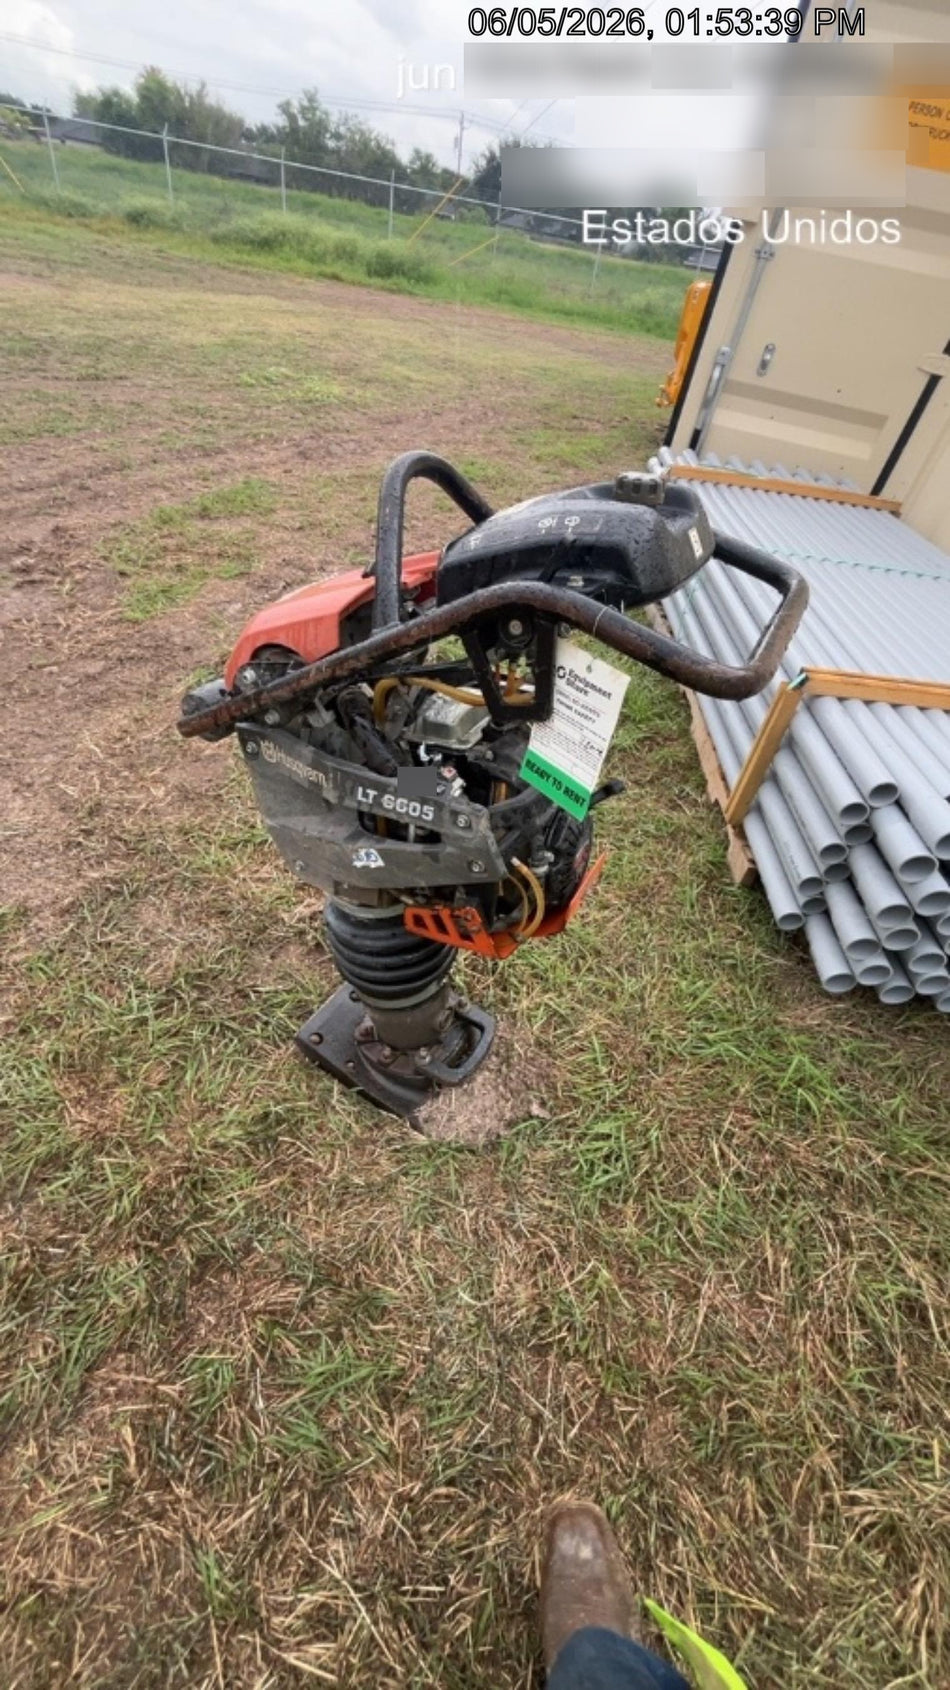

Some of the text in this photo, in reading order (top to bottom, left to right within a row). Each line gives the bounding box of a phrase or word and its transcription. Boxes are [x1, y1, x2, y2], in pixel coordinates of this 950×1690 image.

[568, 668, 612, 700] Equipment
[357, 785, 379, 804] LT
[525, 759, 587, 808] READY TO RENT
